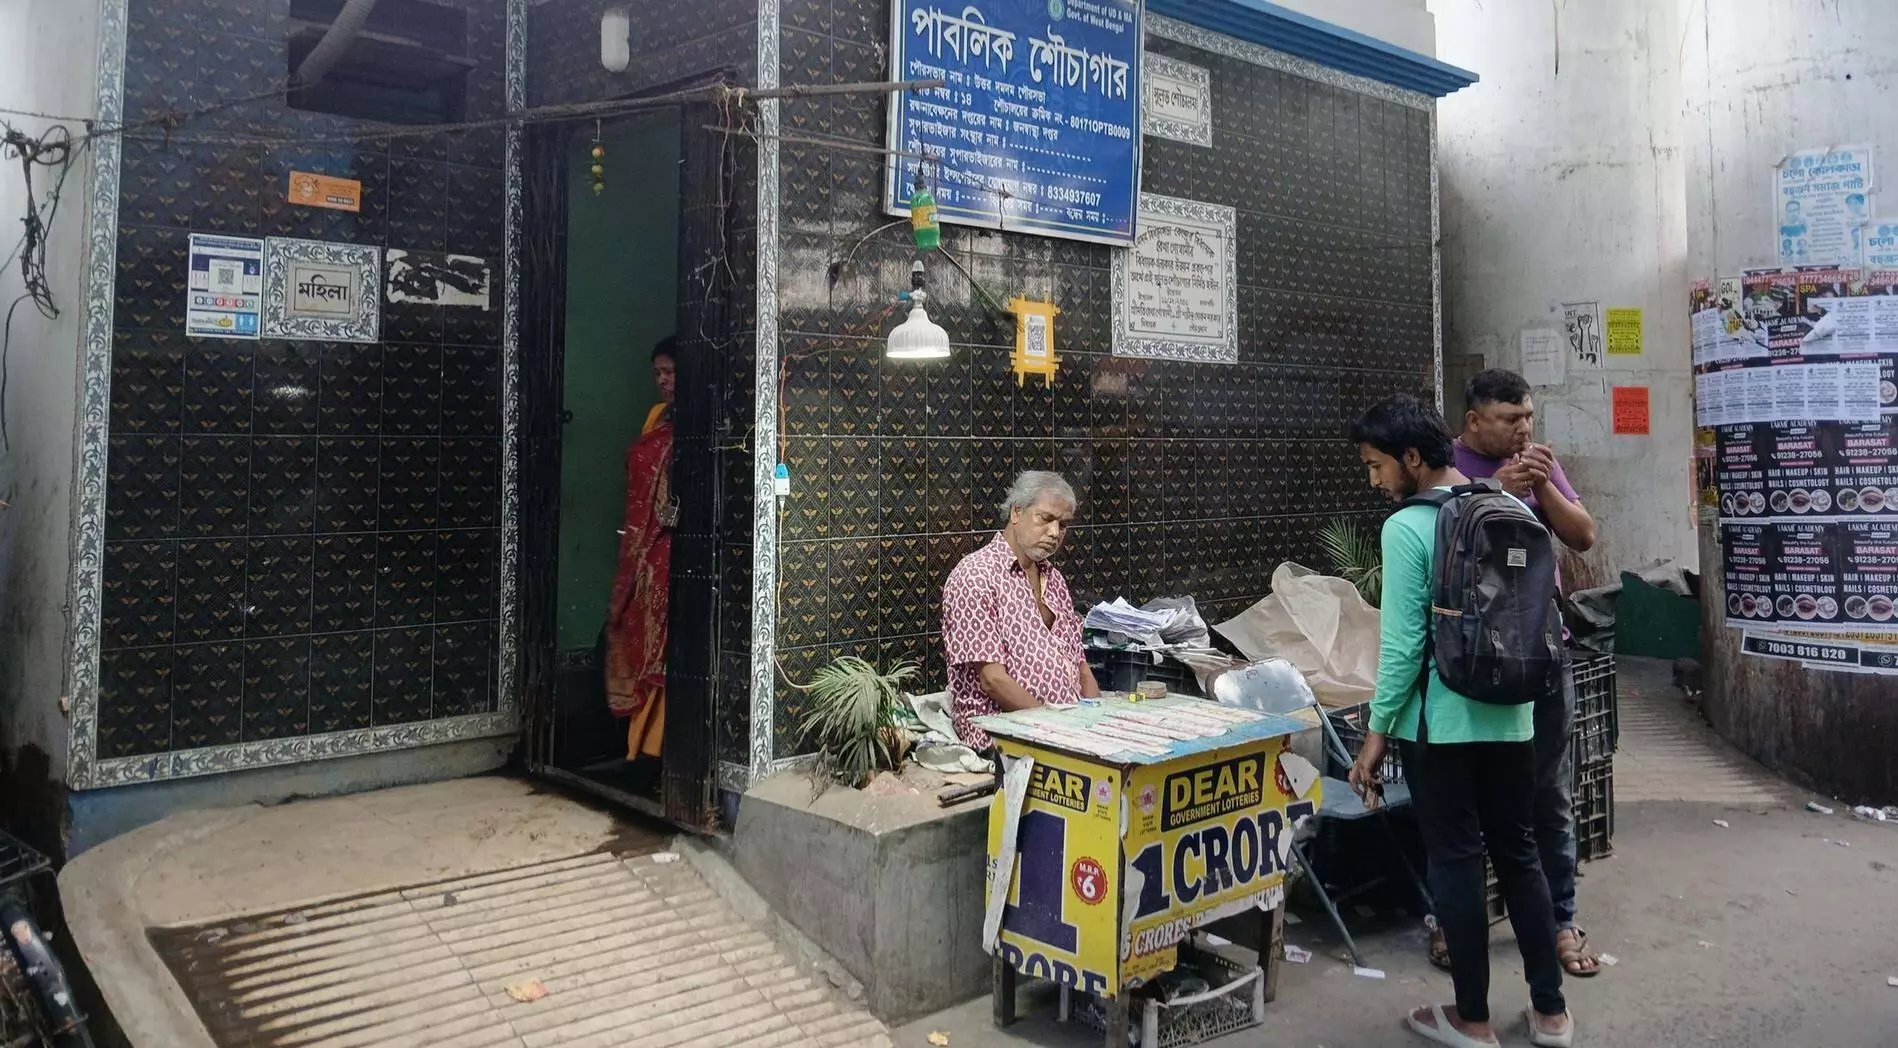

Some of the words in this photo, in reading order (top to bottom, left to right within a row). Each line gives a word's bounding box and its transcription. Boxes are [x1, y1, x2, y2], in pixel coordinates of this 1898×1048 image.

[1067, 7, 1082, 21] Govt.
[1083, 13, 1089, 23] of
[1090, 14, 1104, 28] West
[1105, 19, 1125, 34] Bengal
[1101, 6, 1107, 16] of
[1118, 10, 1123, 20] &
[1124, 12, 1133, 24] MA
[911, 5, 1016, 75] পাবলিক
[1028, 24, 1129, 100] শৌচাগার
[949, 70, 963, 85] নাম
[989, 116, 1002, 129] নাম
[986, 133, 999, 147] নাম
[1006, 157, 1018, 171] নাম
[1048, 185, 1101, 207] 8334937607
[298, 274, 349, 303] মহিলা
[1800, 283, 1817, 293] SPA
[1778, 442, 1812, 450] BARASAT
[1847, 439, 1886, 447] BARASAT
[1786, 468, 1808, 476] MAKEUP
[1835, 466, 1850, 474] HAIR
[1856, 466, 1882, 474] MAKEUP
[1789, 479, 1829, 487] COSMETOLOGY
[1835, 478, 1853, 486] NAILS
[1856, 546, 1896, 554] BARASAT
[1792, 573, 1815, 581] MAKEUP
[1821, 574, 1834, 582] SKIN
[1843, 573, 1858, 581] HAIR
[1864, 573, 1891, 581] MAKEUP
[1775, 584, 1790, 592] NAILS
[1795, 584, 1836, 593] COSMETOLOGY
[1843, 584, 1861, 592] NAILS
[1768, 642, 1794, 655] 7003
[1032, 762, 1085, 801] EAR
[1170, 758, 1259, 812] DEAR
[1050, 791, 1085, 811] LOTTERIES
[1170, 801, 1220, 826] GOVERNMENT
[1222, 790, 1260, 811] LOTTERIES
[1131, 844, 1170, 918] 1
[1135, 915, 1192, 957] CRORES
